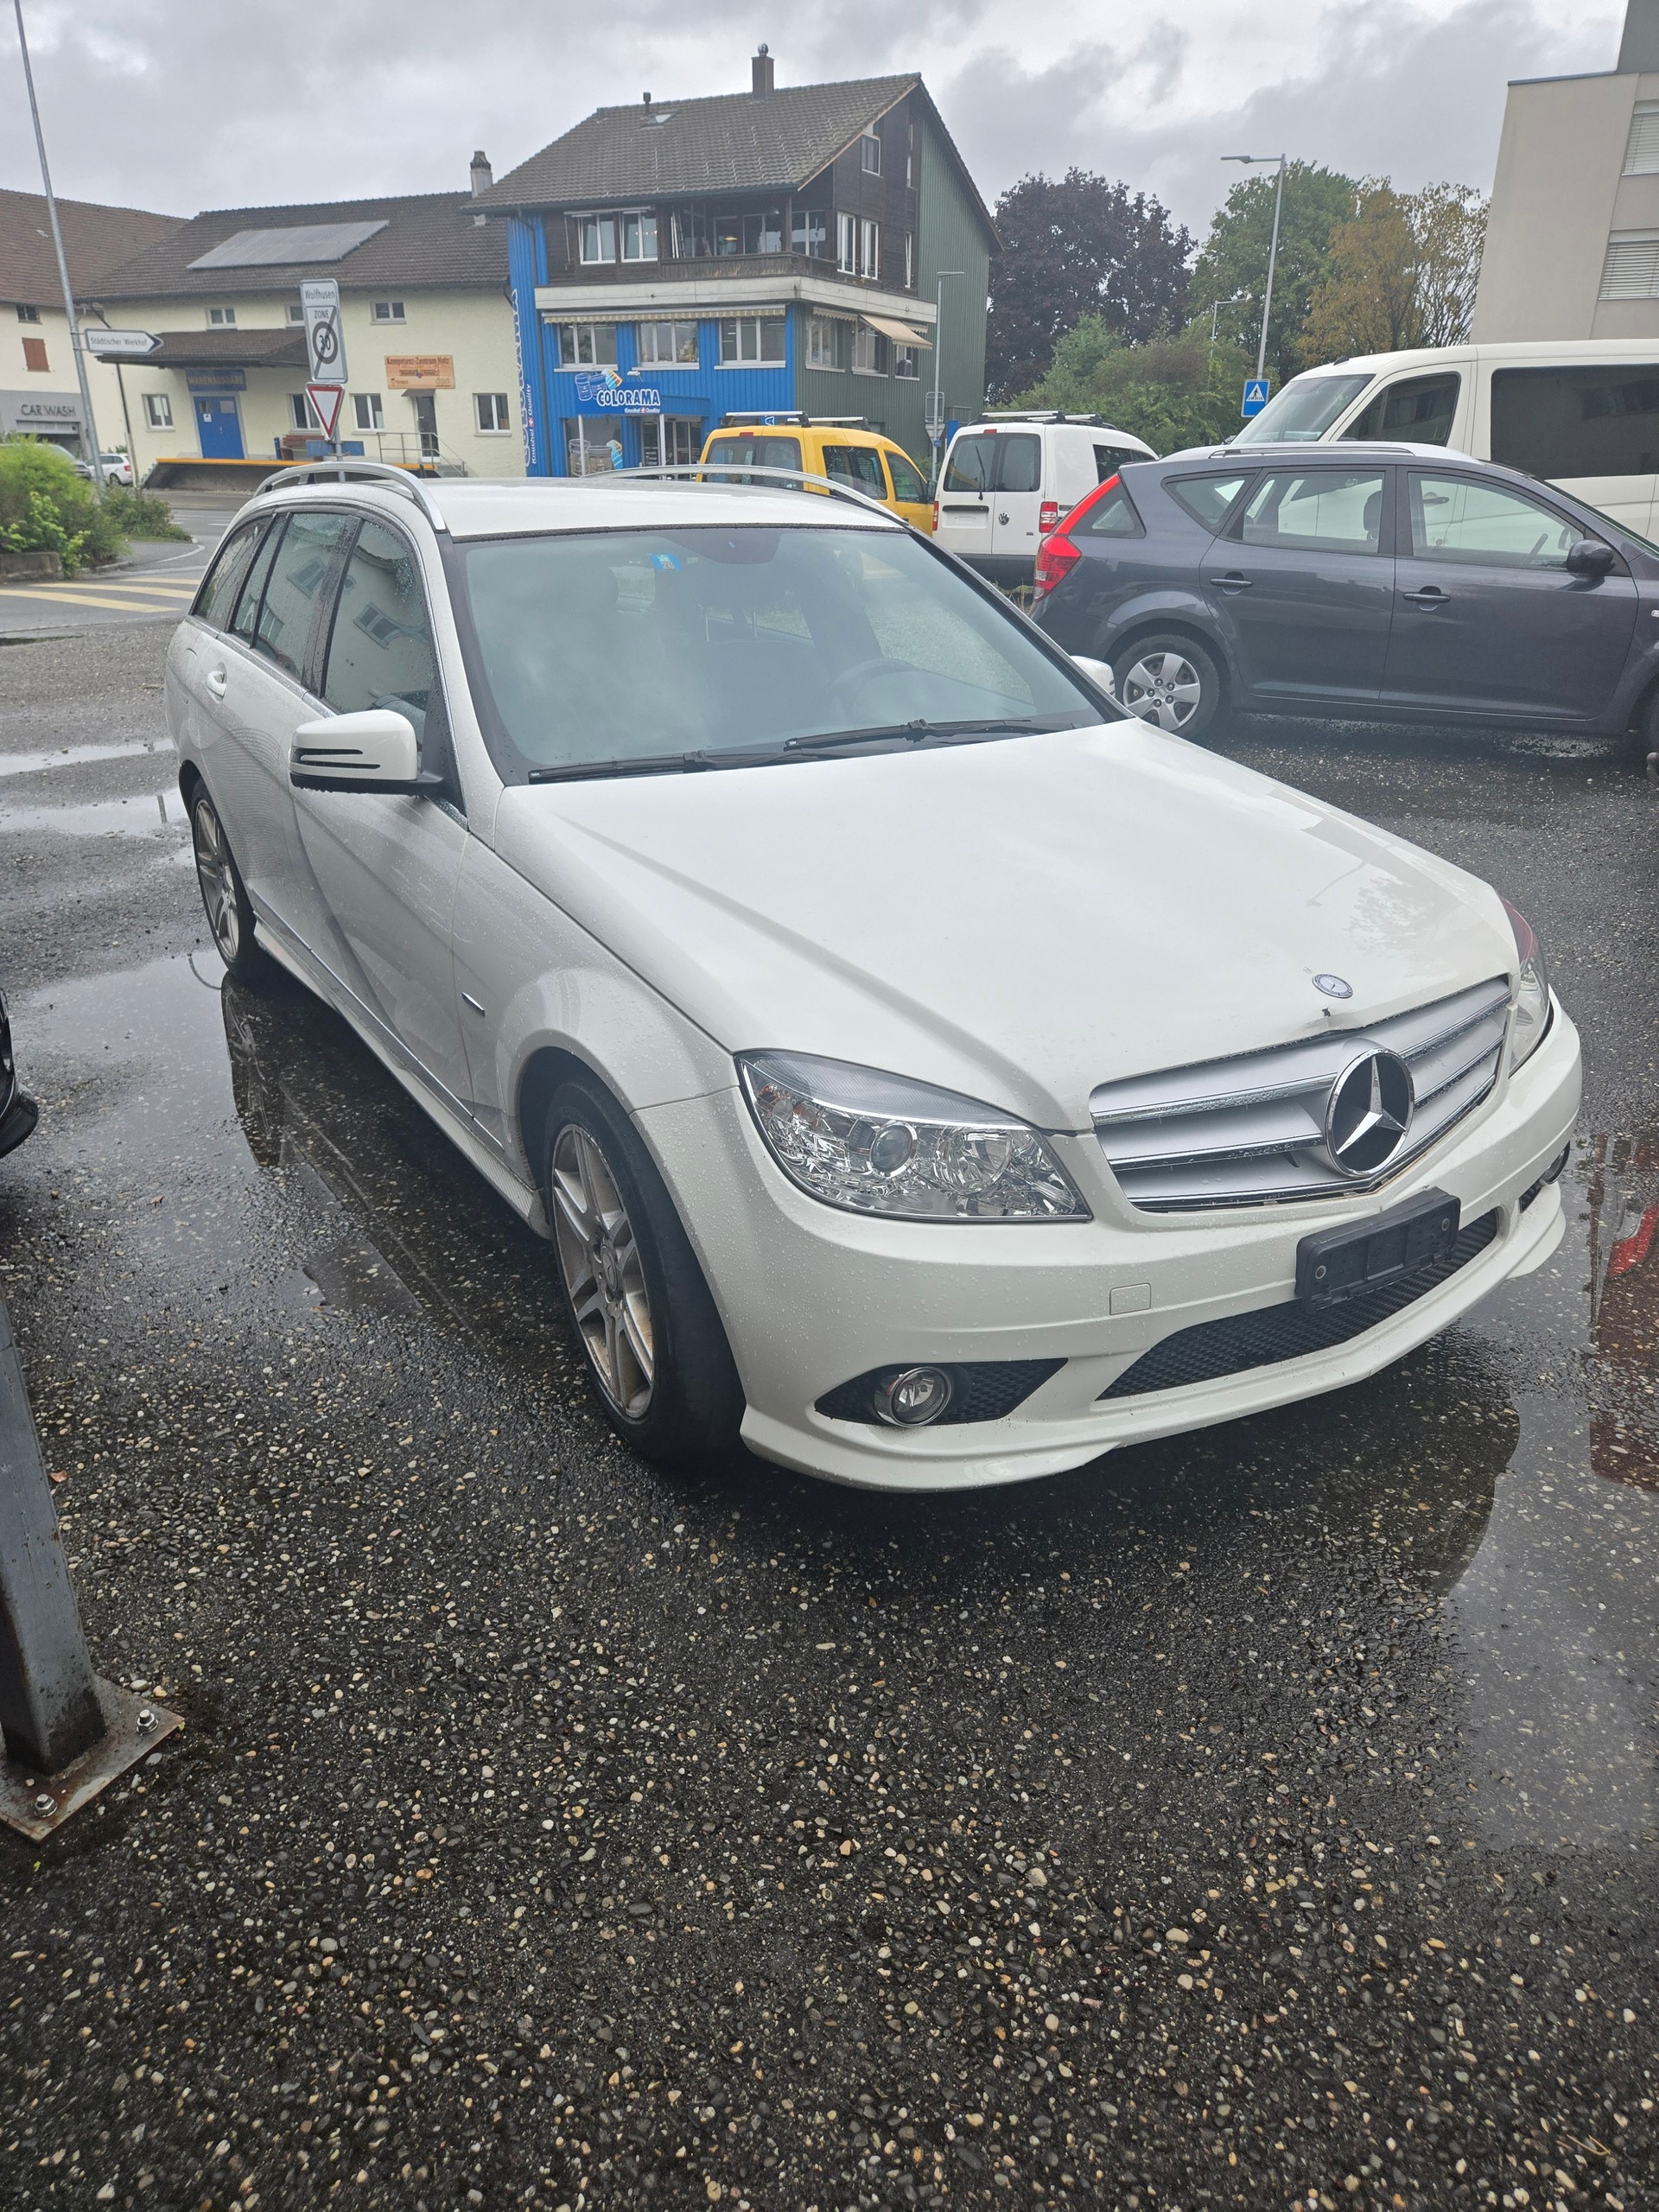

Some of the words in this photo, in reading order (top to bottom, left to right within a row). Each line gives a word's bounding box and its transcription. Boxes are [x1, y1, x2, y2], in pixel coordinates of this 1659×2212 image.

[305, 288, 336, 300] Wolfhusen
[314, 309, 329, 319] ZONE
[90, 337, 121, 346] Städtischer
[124, 338, 148, 346] Werkhof
[319, 334, 331, 351] 30
[596, 389, 661, 407] COLORAMA
[21, 404, 42, 416] CAR
[43, 404, 76, 417] WASH
